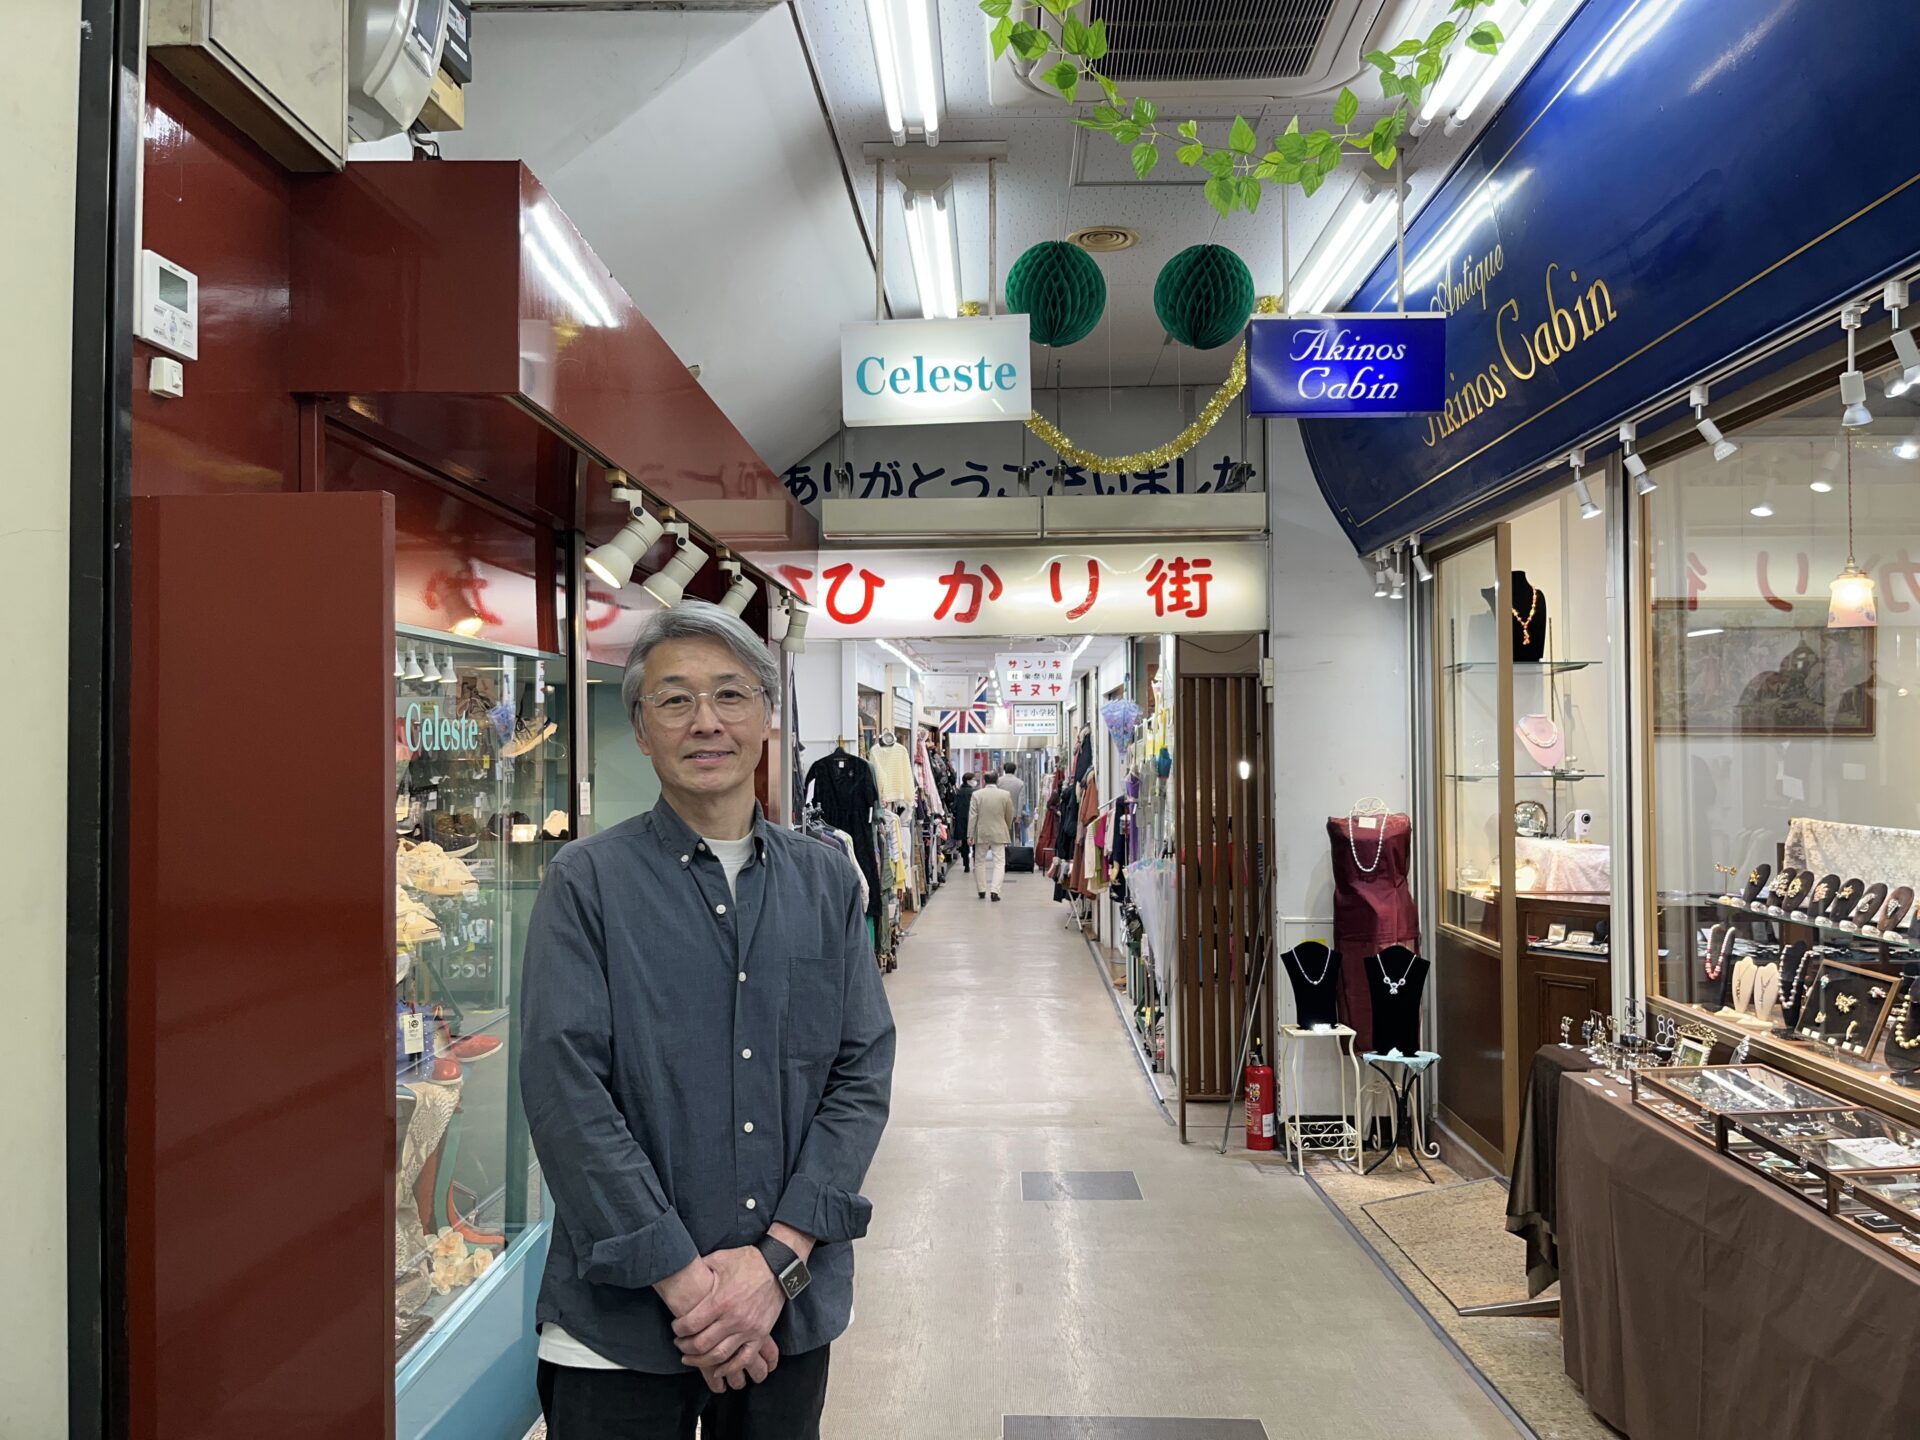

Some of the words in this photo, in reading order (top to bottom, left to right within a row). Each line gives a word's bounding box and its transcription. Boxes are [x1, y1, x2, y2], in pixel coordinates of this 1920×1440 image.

[1430, 244, 1504, 316] Antique
[1496, 262, 1618, 381] Cabin
[1290, 328, 1407, 362] Akinos
[855, 356, 1018, 396] Celeste
[1297, 367, 1400, 401] Cabin
[822, 556, 1213, 625] ひかり街
[1008, 660, 1062, 669] サンリキ
[1009, 683, 1062, 697] キヌヤ
[404, 702, 479, 753] Celeste
